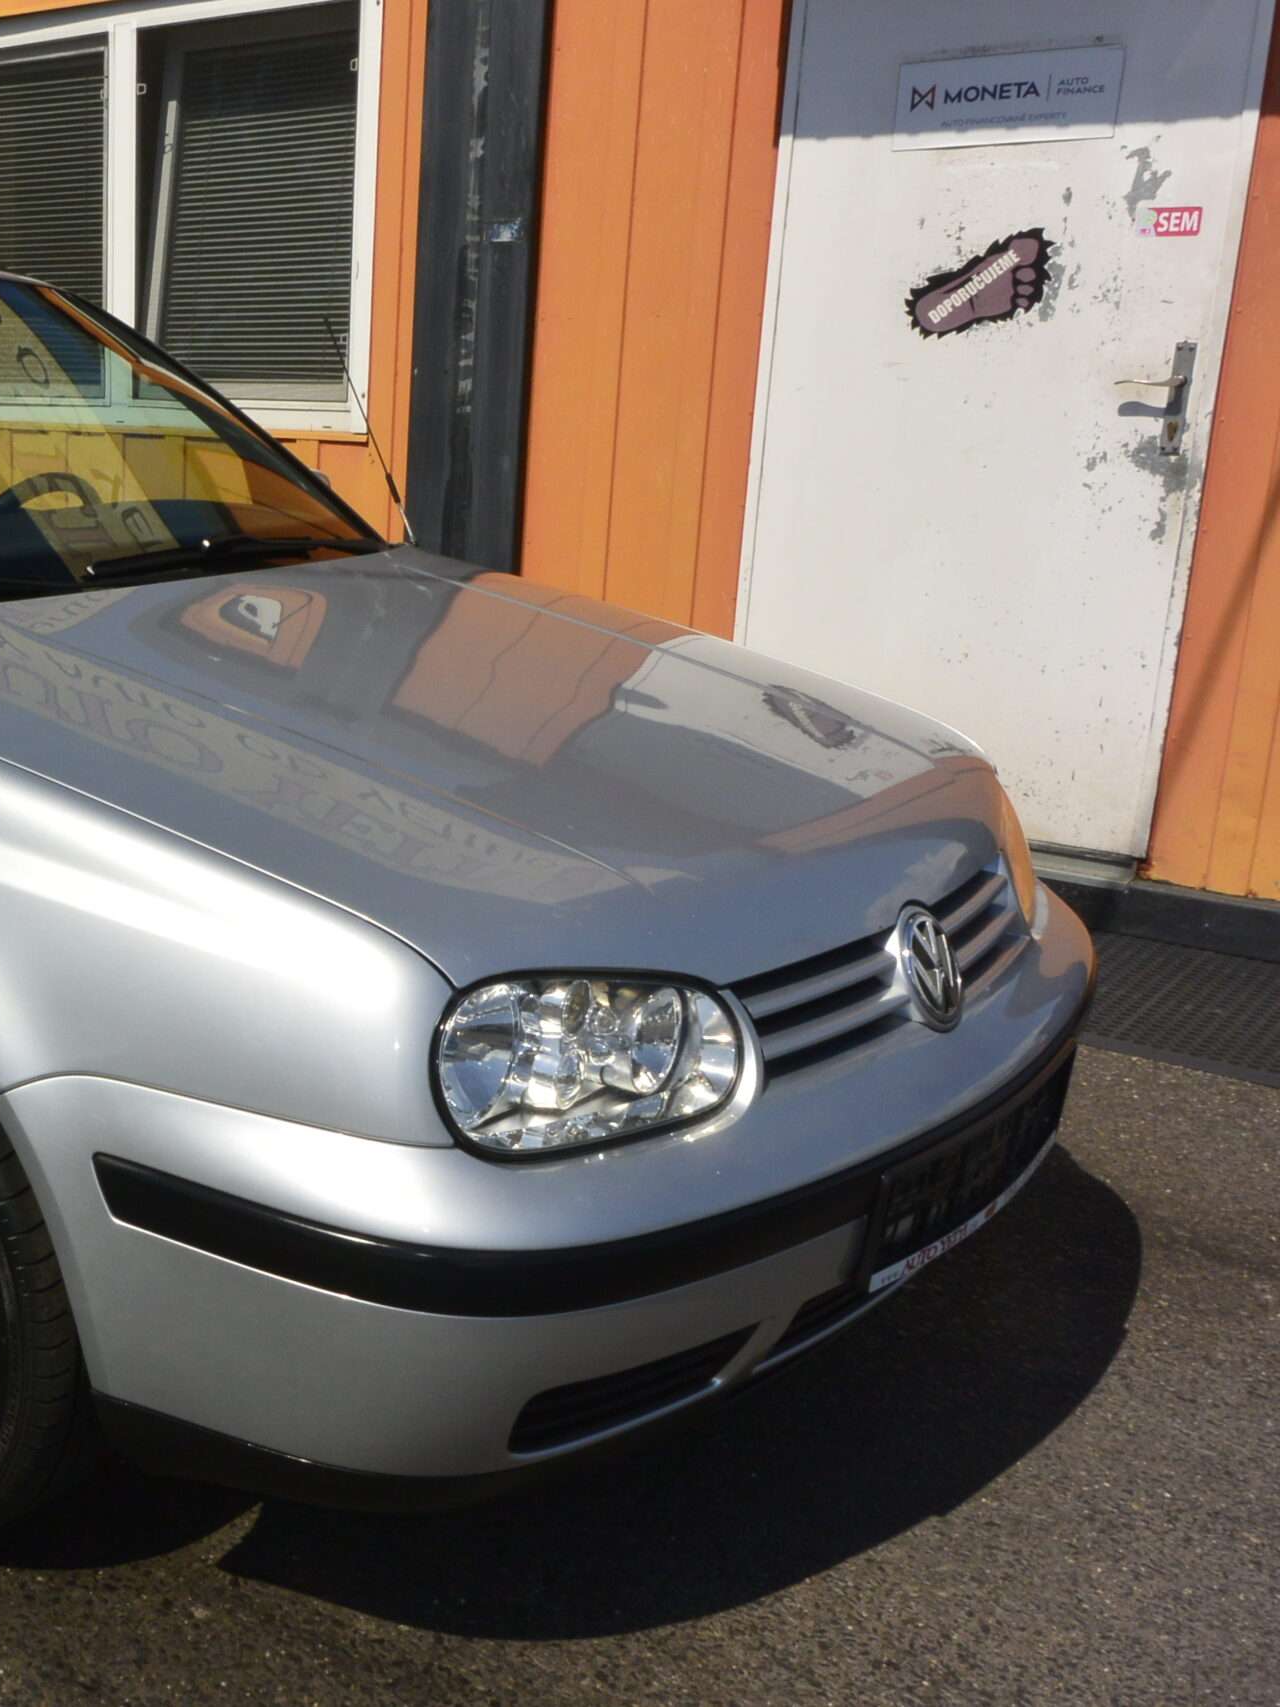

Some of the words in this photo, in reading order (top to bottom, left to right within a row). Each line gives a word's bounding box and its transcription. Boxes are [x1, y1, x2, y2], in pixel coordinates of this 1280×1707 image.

[1056, 84, 1106, 96] FINANCE
[1057, 76, 1090, 87] AUTO
[943, 82, 1041, 104] MONETA
[1156, 210, 1200, 233] SEM
[927, 249, 1021, 324] DOPORUČUJEME
[905, 907, 961, 1026] VW
